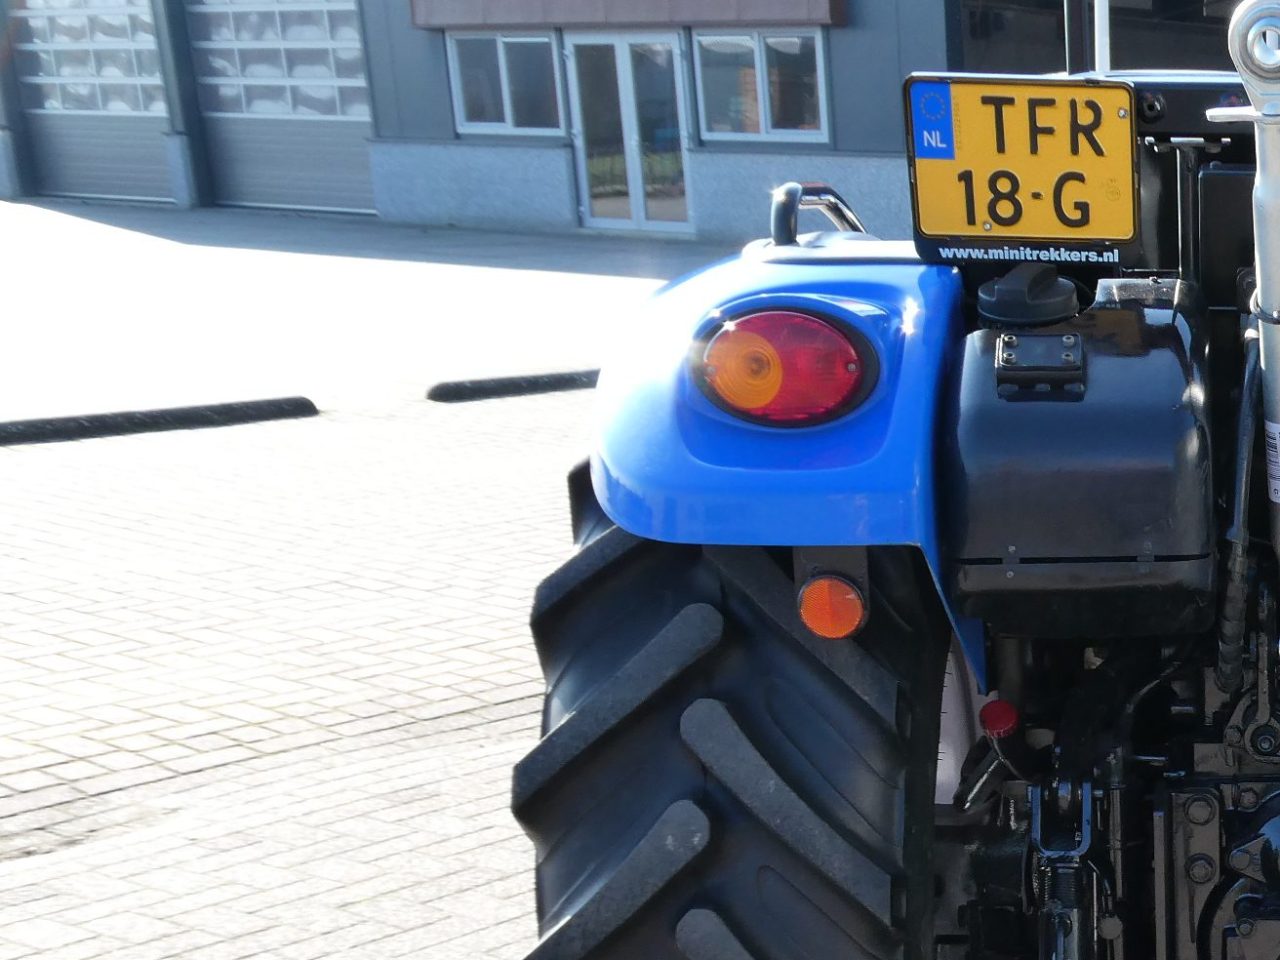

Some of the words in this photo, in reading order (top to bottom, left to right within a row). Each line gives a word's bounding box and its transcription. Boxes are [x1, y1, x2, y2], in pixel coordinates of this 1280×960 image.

[922, 130, 947, 148] NL
[980, 95, 1106, 157] TFR
[957, 169, 1091, 228] 18-G
[939, 245, 1119, 263] www.minitrekkers.nl
